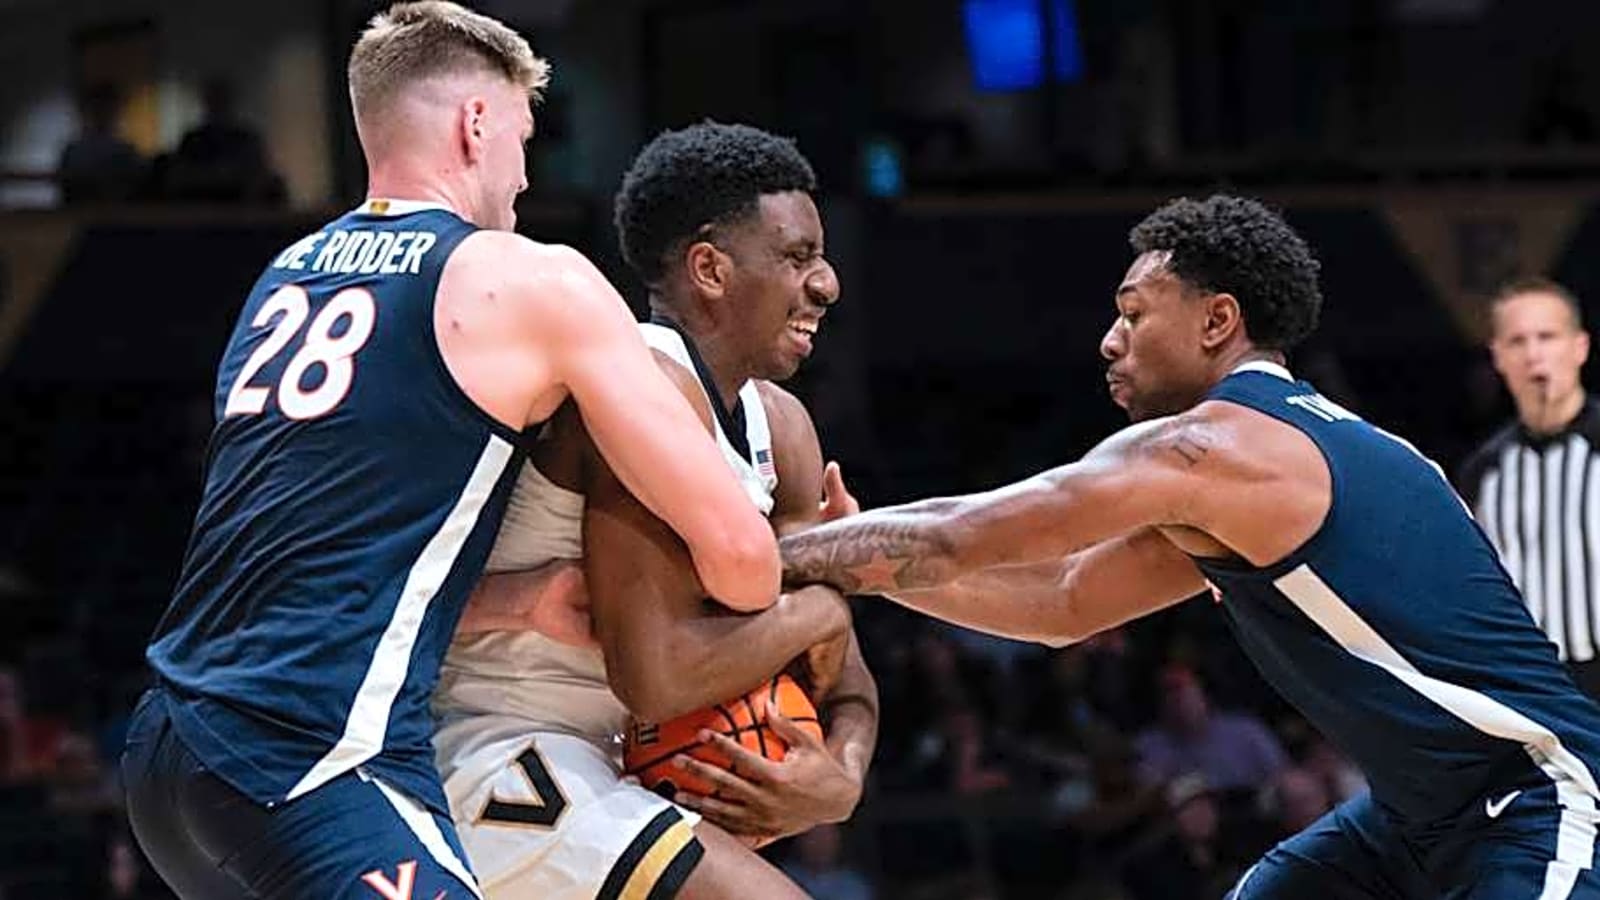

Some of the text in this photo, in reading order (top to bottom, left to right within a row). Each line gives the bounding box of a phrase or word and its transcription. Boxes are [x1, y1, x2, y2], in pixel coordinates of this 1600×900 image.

[272, 230, 437, 275] DE RIDDER
[224, 283, 377, 421] 28
[472, 738, 573, 831] V
